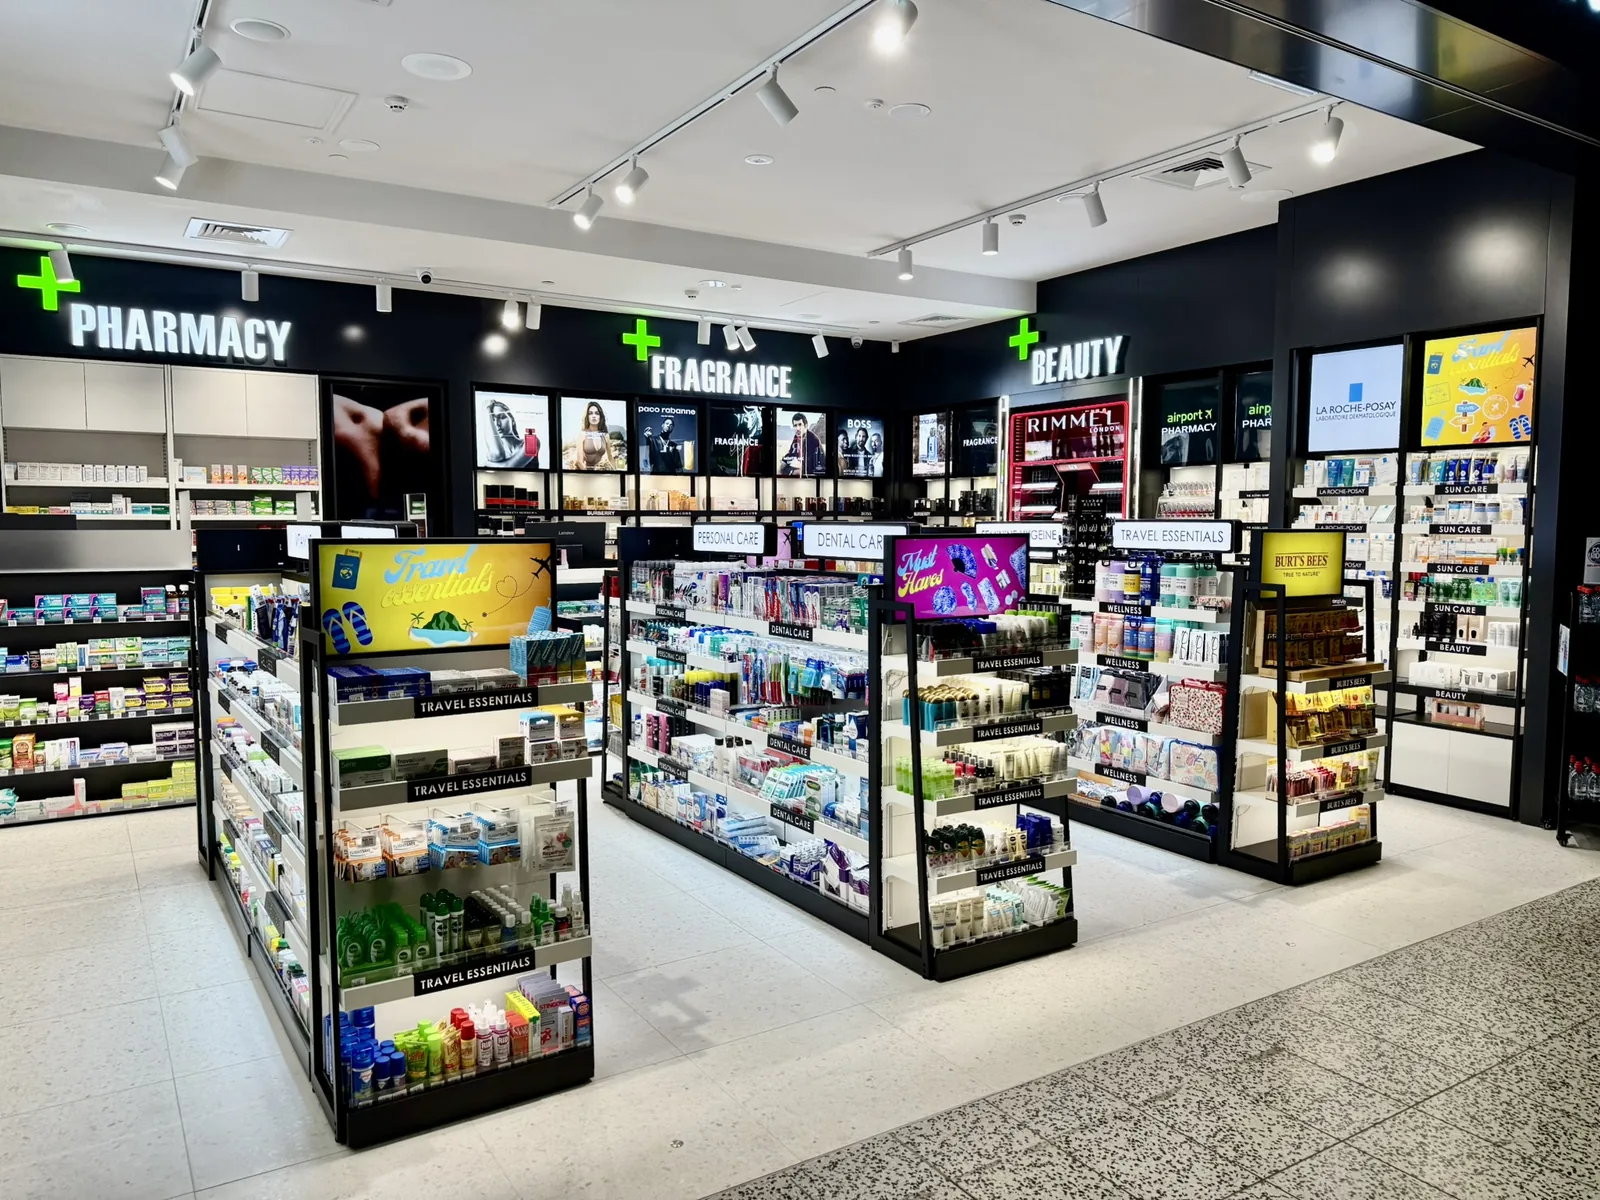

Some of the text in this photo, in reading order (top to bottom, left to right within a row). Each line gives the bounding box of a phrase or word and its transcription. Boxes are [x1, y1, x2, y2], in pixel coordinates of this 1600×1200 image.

[71, 303, 291, 361] PHARMACY
[1031, 336, 1124, 385] BEAUTY
[652, 356, 792, 398] FRAGRANCE
[661, 407, 696, 416] rabanne
[1249, 403, 1271, 416] airp
[1316, 401, 1396, 415] LA ROCHE-POSAY
[847, 418, 872, 428] BOSS
[1027, 410, 1120, 433] RIMMEL
[1167, 409, 1202, 424] airport
[1242, 418, 1272, 429] PHAR
[1089, 425, 1120, 434] LONDON
[1161, 422, 1217, 435] PHARMACY
[714, 437, 759, 447] FRAGRANCE
[963, 436, 998, 447] FRAGRANCE
[1445, 485, 1487, 494] SUN CARE
[1029, 530, 1057, 541] GEINE
[1121, 529, 1224, 543] TRAVEL ESSENTIALS
[1439, 525, 1481, 534] SUN CARE
[698, 531, 759, 546] PERSONAL CARE
[817, 532, 883, 550] DENTAL CAR
[897, 544, 939, 577] Must
[1275, 555, 1305, 568] BURT'S
[1306, 554, 1329, 567] BEES
[1436, 565, 1479, 573] SUN CARE
[381, 562, 495, 608] essentials
[897, 568, 945, 598] Haves
[1107, 604, 1142, 615] WELLNESS
[1434, 604, 1476, 613] SUN CARE
[771, 625, 809, 639] DENTAL CARE
[1439, 644, 1470, 653] BEAUTY
[976, 656, 1041, 669] TRAVEL ESSENTIALS
[1105, 657, 1140, 669] WELLNESS
[420, 693, 533, 712] TRAVEL ESSENTIALS
[1435, 690, 1466, 701] BEAUTY
[1104, 715, 1139, 730] WELLNESS
[977, 723, 1040, 738] TRAVEL ESSENTIALS
[770, 740, 808, 757] DENTAL CARE
[1331, 743, 1361, 755] BURT'S BEES
[1103, 767, 1137, 783] WELLNESS
[414, 773, 527, 796] TRAVEL ESSENTIALS
[978, 788, 1041, 805] TRAVEL ESSENTIALS
[773, 808, 811, 830] DENTAL CARE
[980, 862, 1043, 881] TRAVEL ESSENTIALS
[420, 957, 530, 989] TRAVEL ESSENTIALS
[539, 1001, 568, 1010] STINGOSE
[481, 1041, 492, 1050] RID
[498, 1036, 509, 1044] RID
